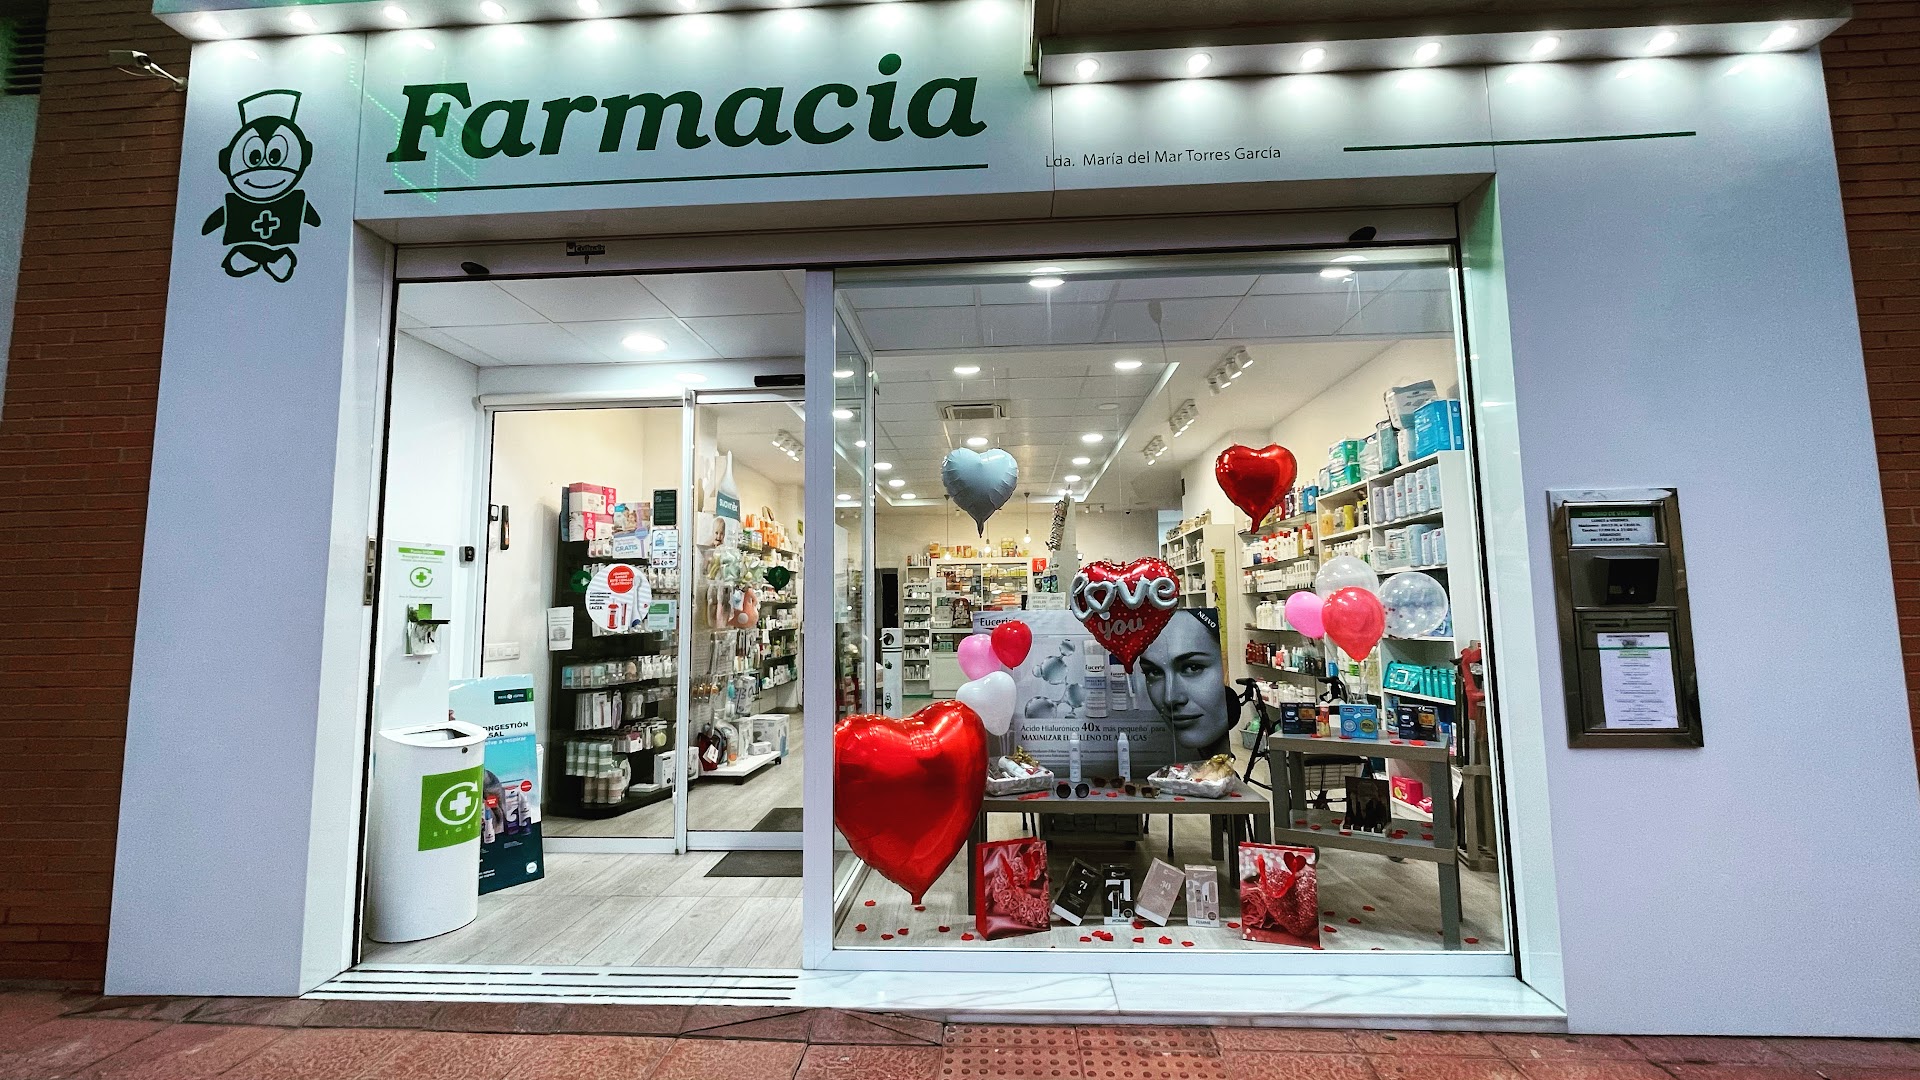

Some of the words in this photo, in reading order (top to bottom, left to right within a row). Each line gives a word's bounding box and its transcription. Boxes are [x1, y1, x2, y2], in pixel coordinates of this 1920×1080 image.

[386, 53, 987, 162] Farmacia
[1045, 155, 1075, 168] Lda.
[1083, 152, 1123, 166] María
[1127, 150, 1150, 164] del
[1154, 150, 1182, 163] Mar
[1185, 149, 1230, 162] Torres
[1234, 146, 1281, 160] García
[615, 544, 638, 553] GRATIS
[1097, 617, 1145, 640] you
[1081, 722, 1101, 732] 40x
